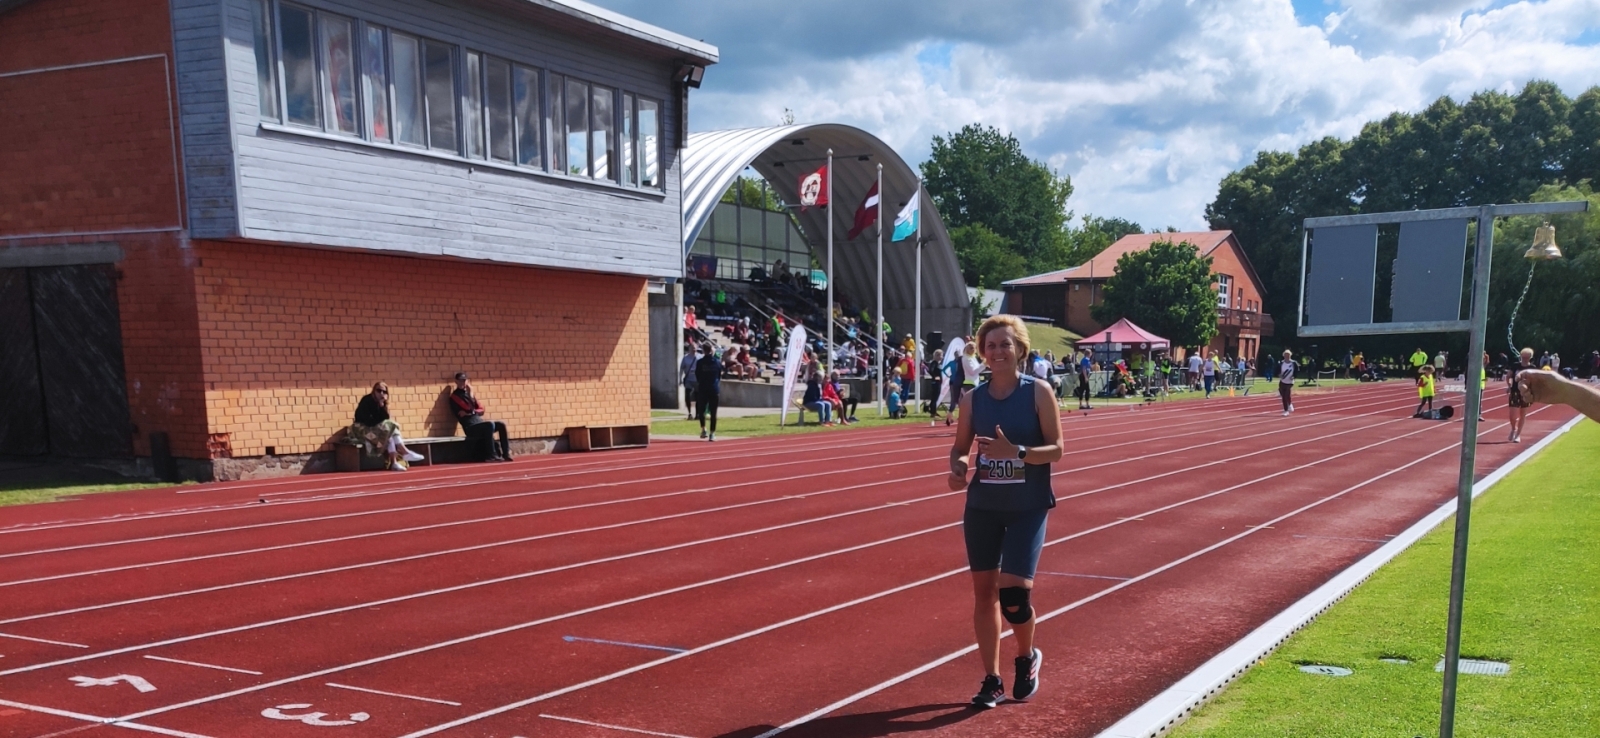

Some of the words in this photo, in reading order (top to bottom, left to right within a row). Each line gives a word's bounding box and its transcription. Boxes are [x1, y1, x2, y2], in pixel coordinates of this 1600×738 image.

[989, 459, 1014, 479] 250
[68, 674, 157, 693] 4
[260, 703, 371, 727] 3
